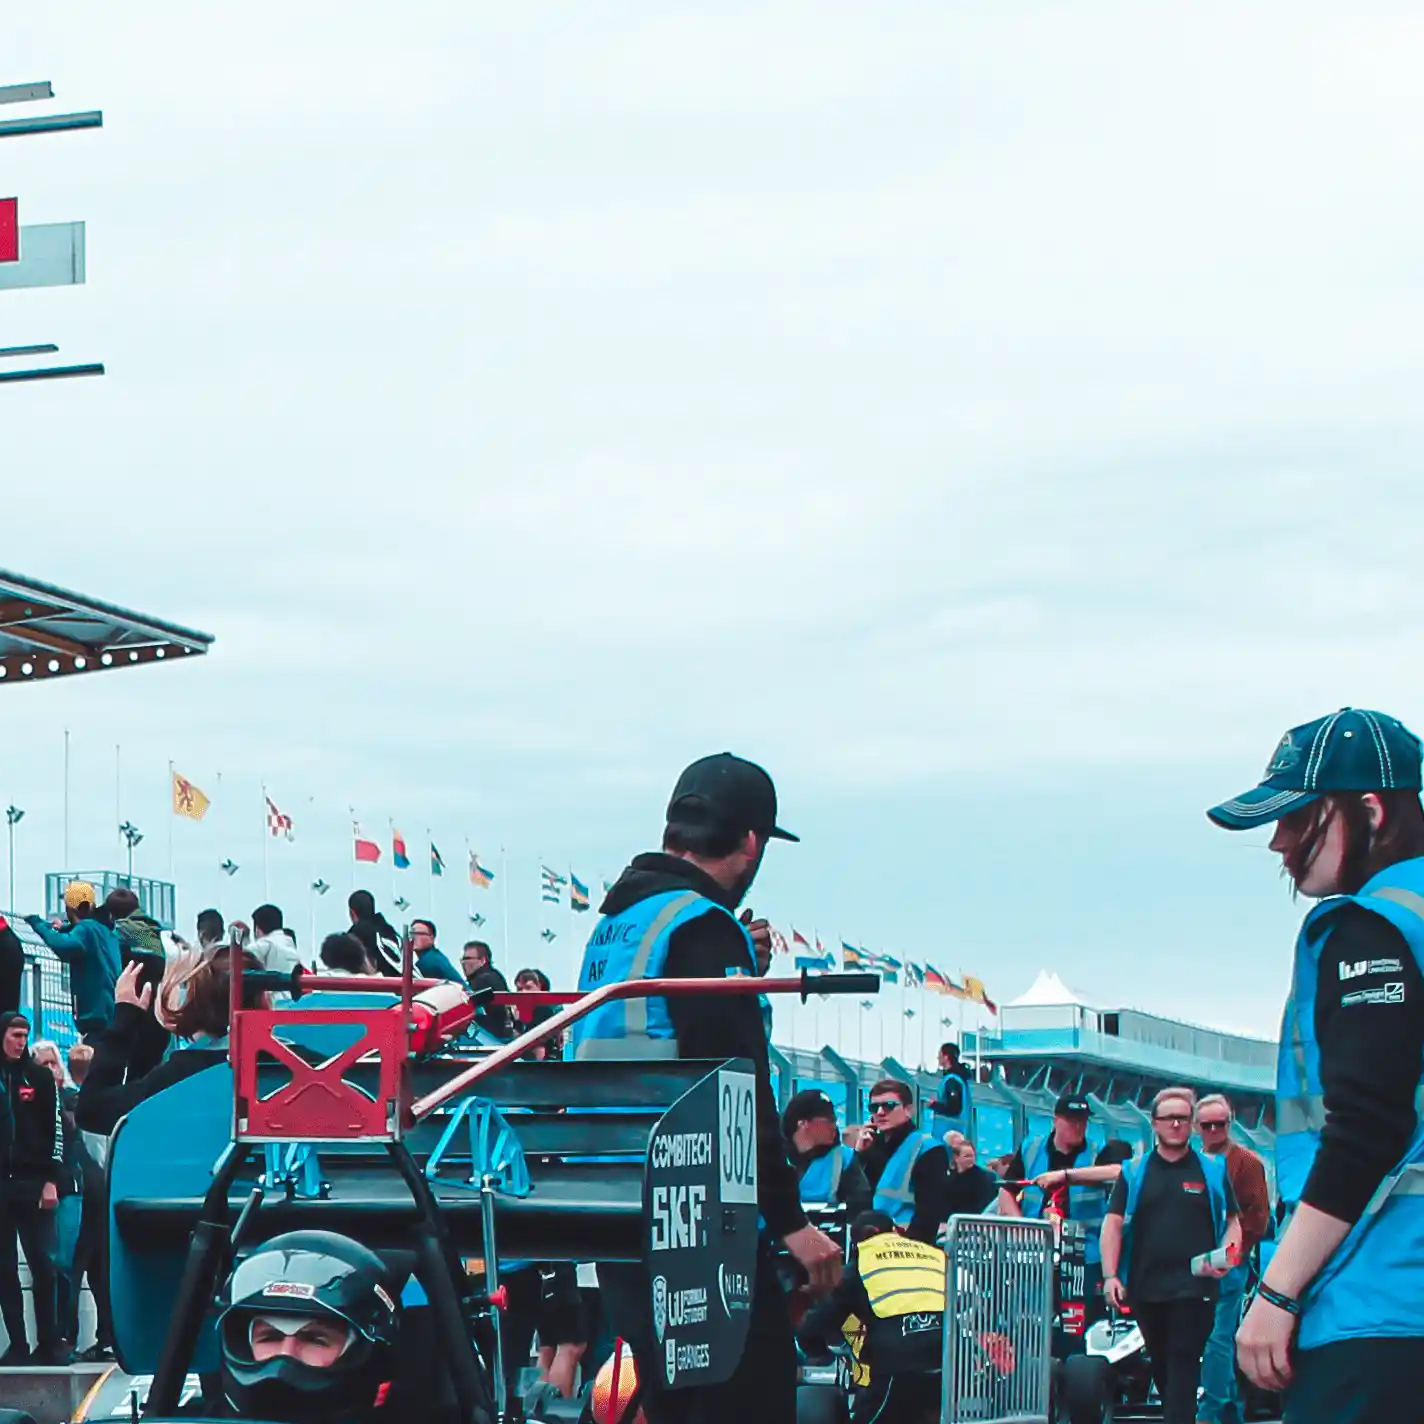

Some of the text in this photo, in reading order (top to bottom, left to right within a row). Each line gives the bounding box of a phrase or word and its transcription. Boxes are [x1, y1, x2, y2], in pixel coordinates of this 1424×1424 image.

[652, 1132, 712, 1168] COMBITECH
[722, 1083, 754, 1186] 362
[725, 1273, 749, 1296] NIRA
